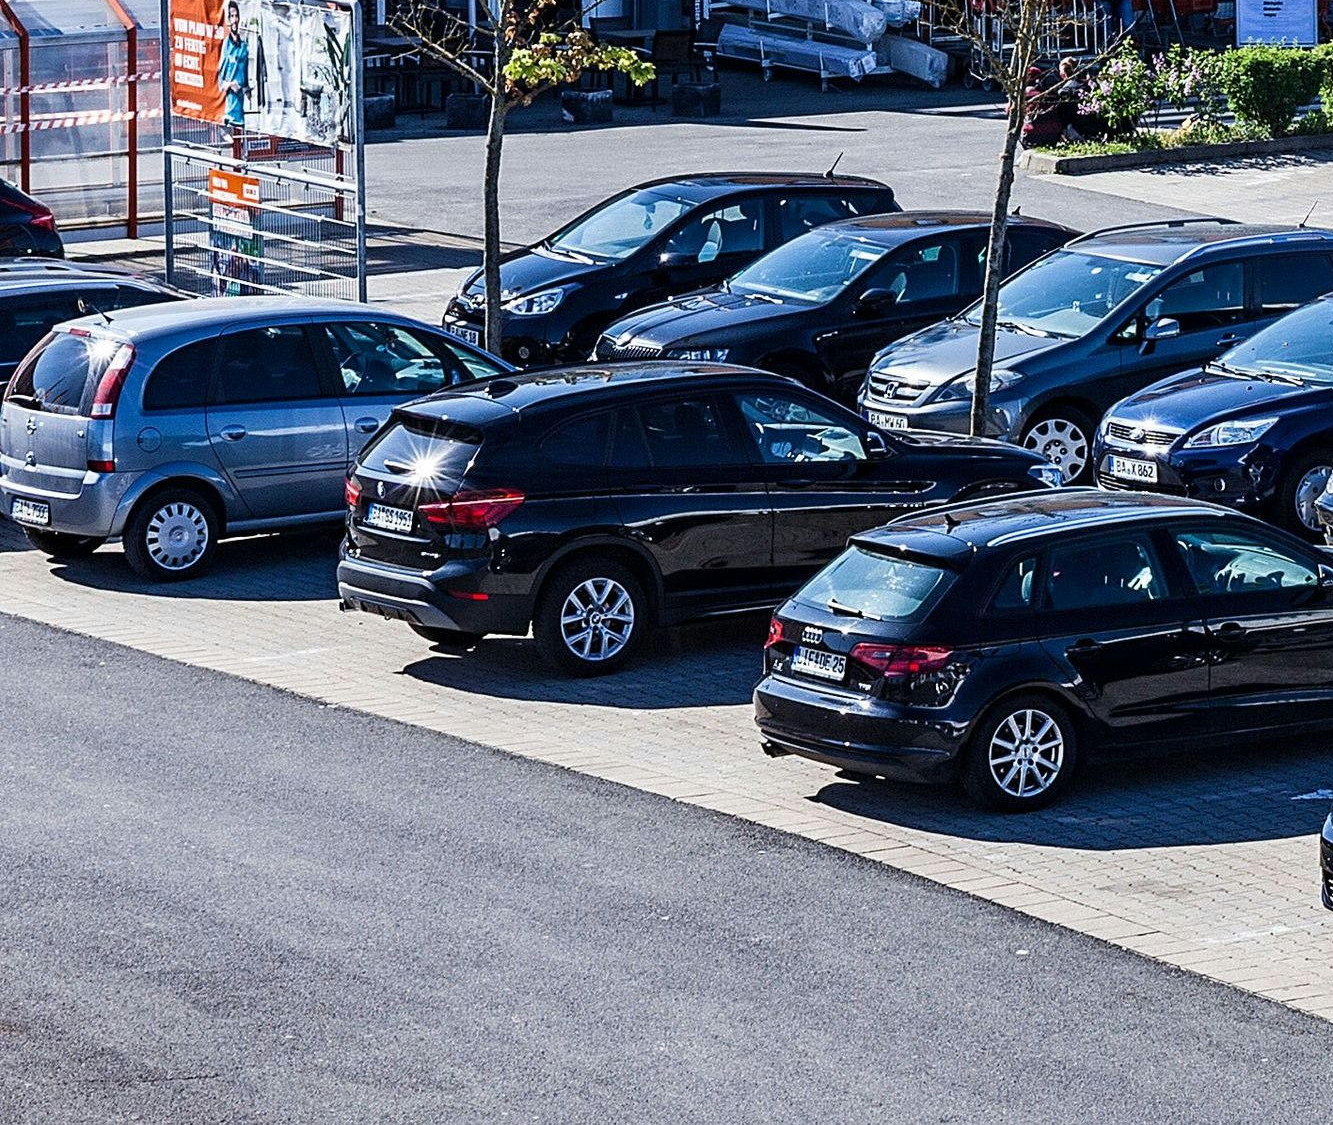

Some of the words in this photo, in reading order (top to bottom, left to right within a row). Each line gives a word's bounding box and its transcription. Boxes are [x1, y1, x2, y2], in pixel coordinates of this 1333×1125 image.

[1117, 460, 1127, 474] BA
[1138, 464, 1154, 478] 862
[832, 656, 845, 674] 25
